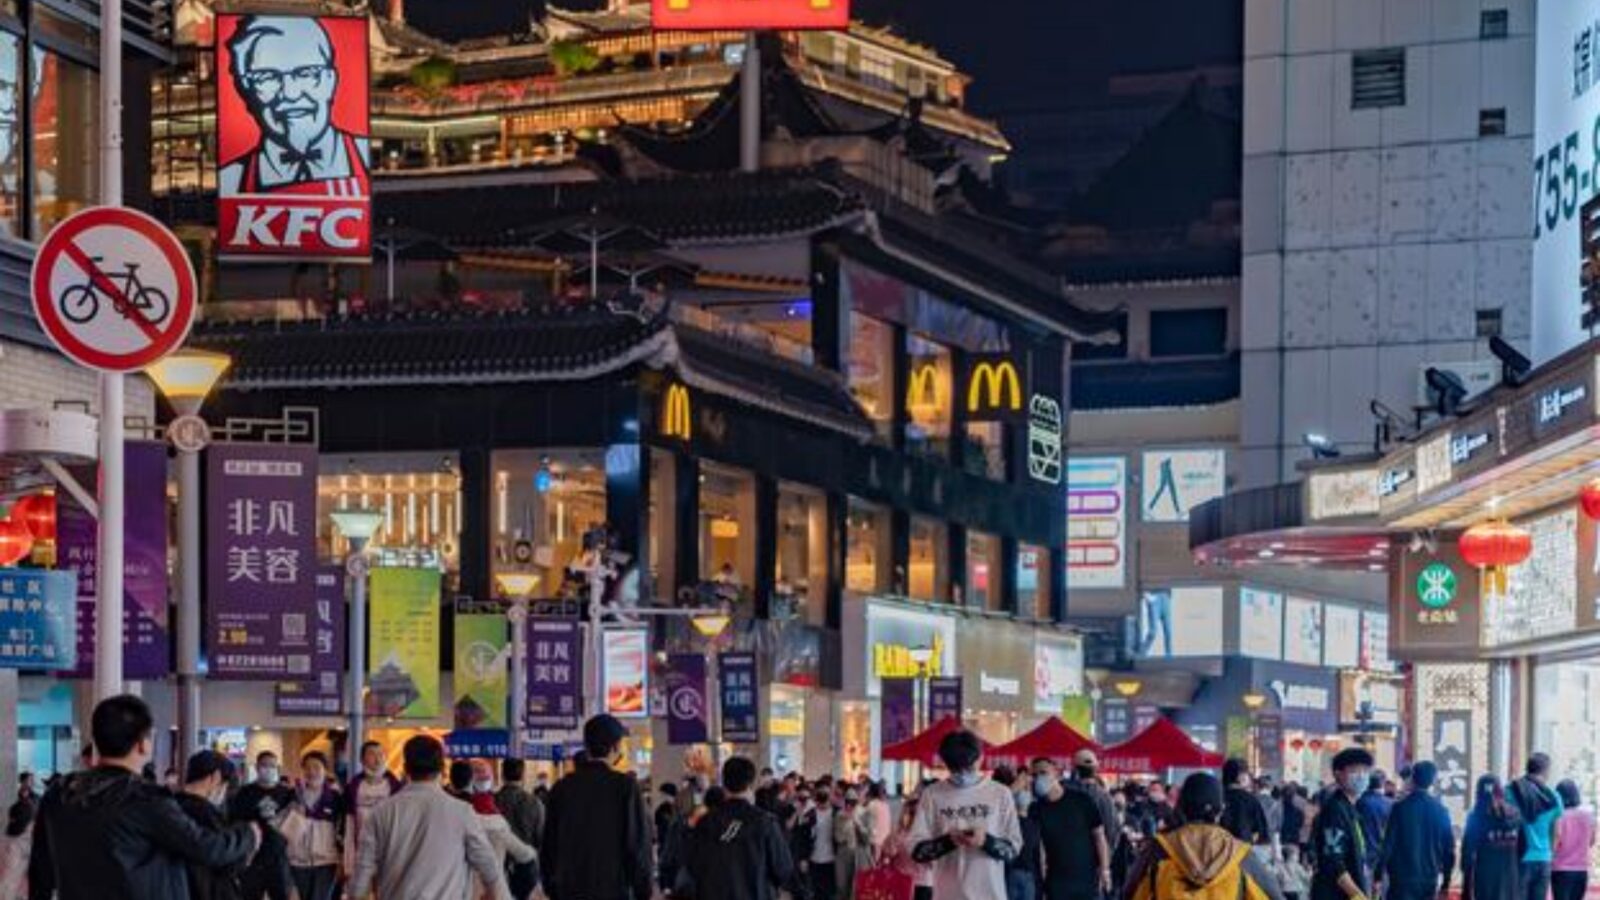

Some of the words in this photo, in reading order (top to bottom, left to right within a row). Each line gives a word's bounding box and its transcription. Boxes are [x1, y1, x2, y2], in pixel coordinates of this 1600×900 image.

[228, 204, 364, 249] KFC
[226, 498, 299, 536] 非凡
[226, 547, 299, 583] 美容
